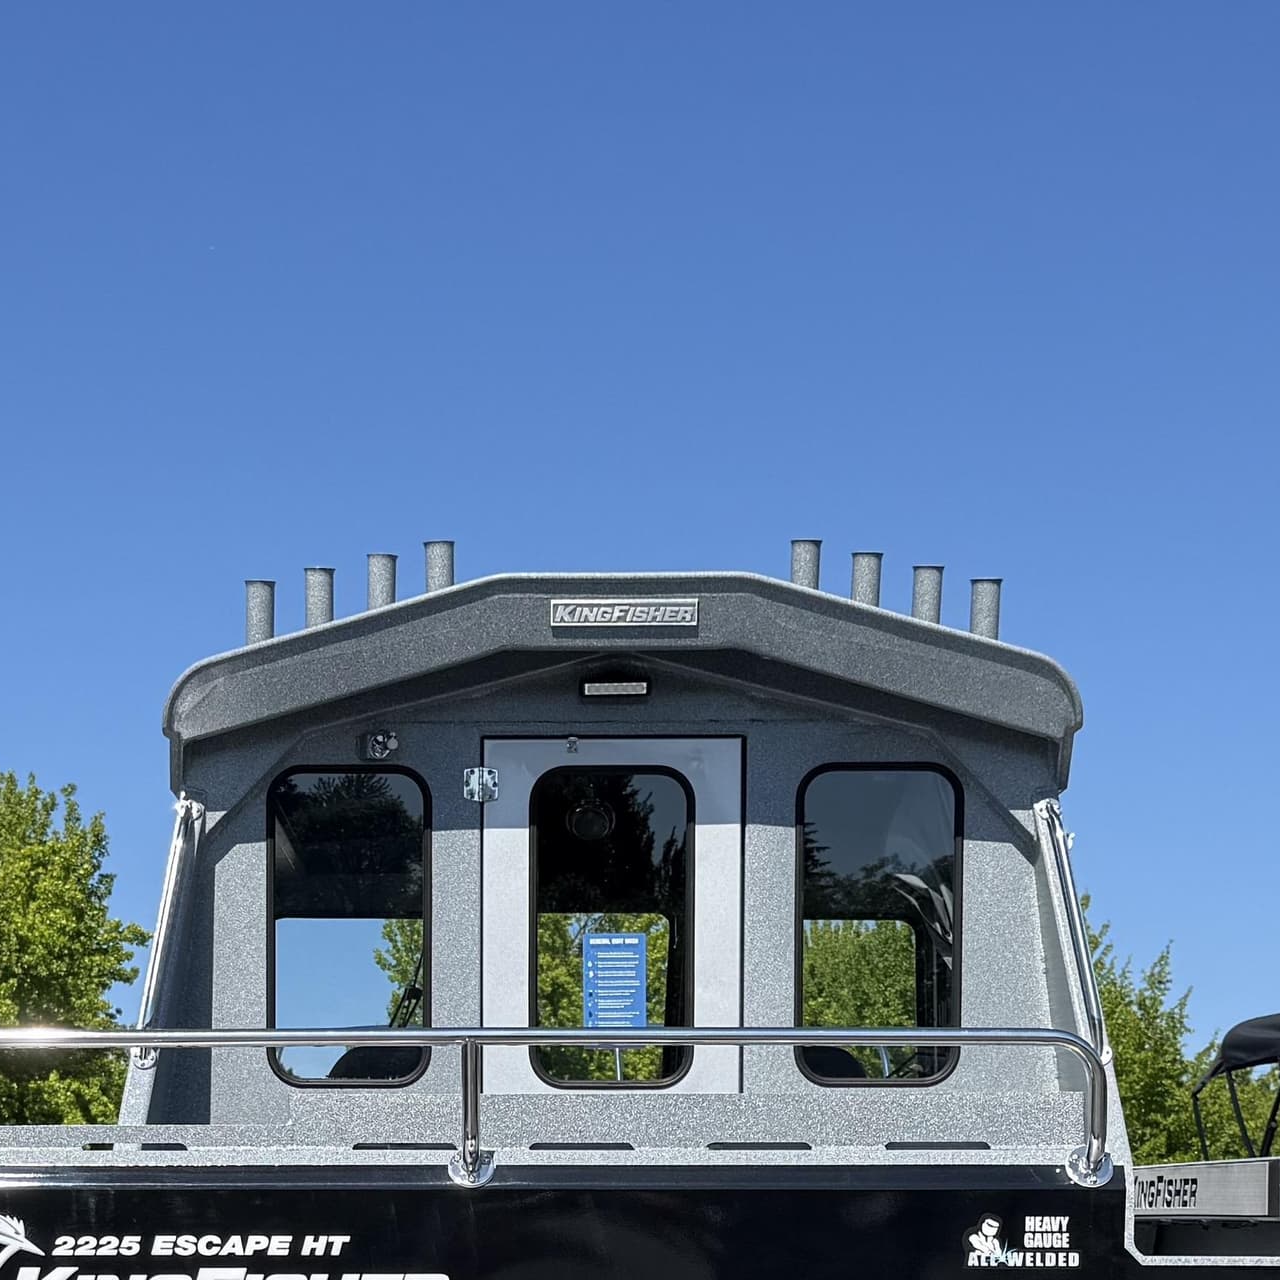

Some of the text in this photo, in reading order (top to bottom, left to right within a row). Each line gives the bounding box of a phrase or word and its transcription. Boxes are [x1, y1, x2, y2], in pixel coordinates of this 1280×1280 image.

[554, 605, 694, 622] KINGFISHER
[1024, 1215, 1070, 1232] HEAVY
[51, 1235, 351, 1256] 2225 ESCAPE HT
[1023, 1232, 1070, 1249] GAUGE
[967, 1252, 1080, 1267] ALL WELDED
